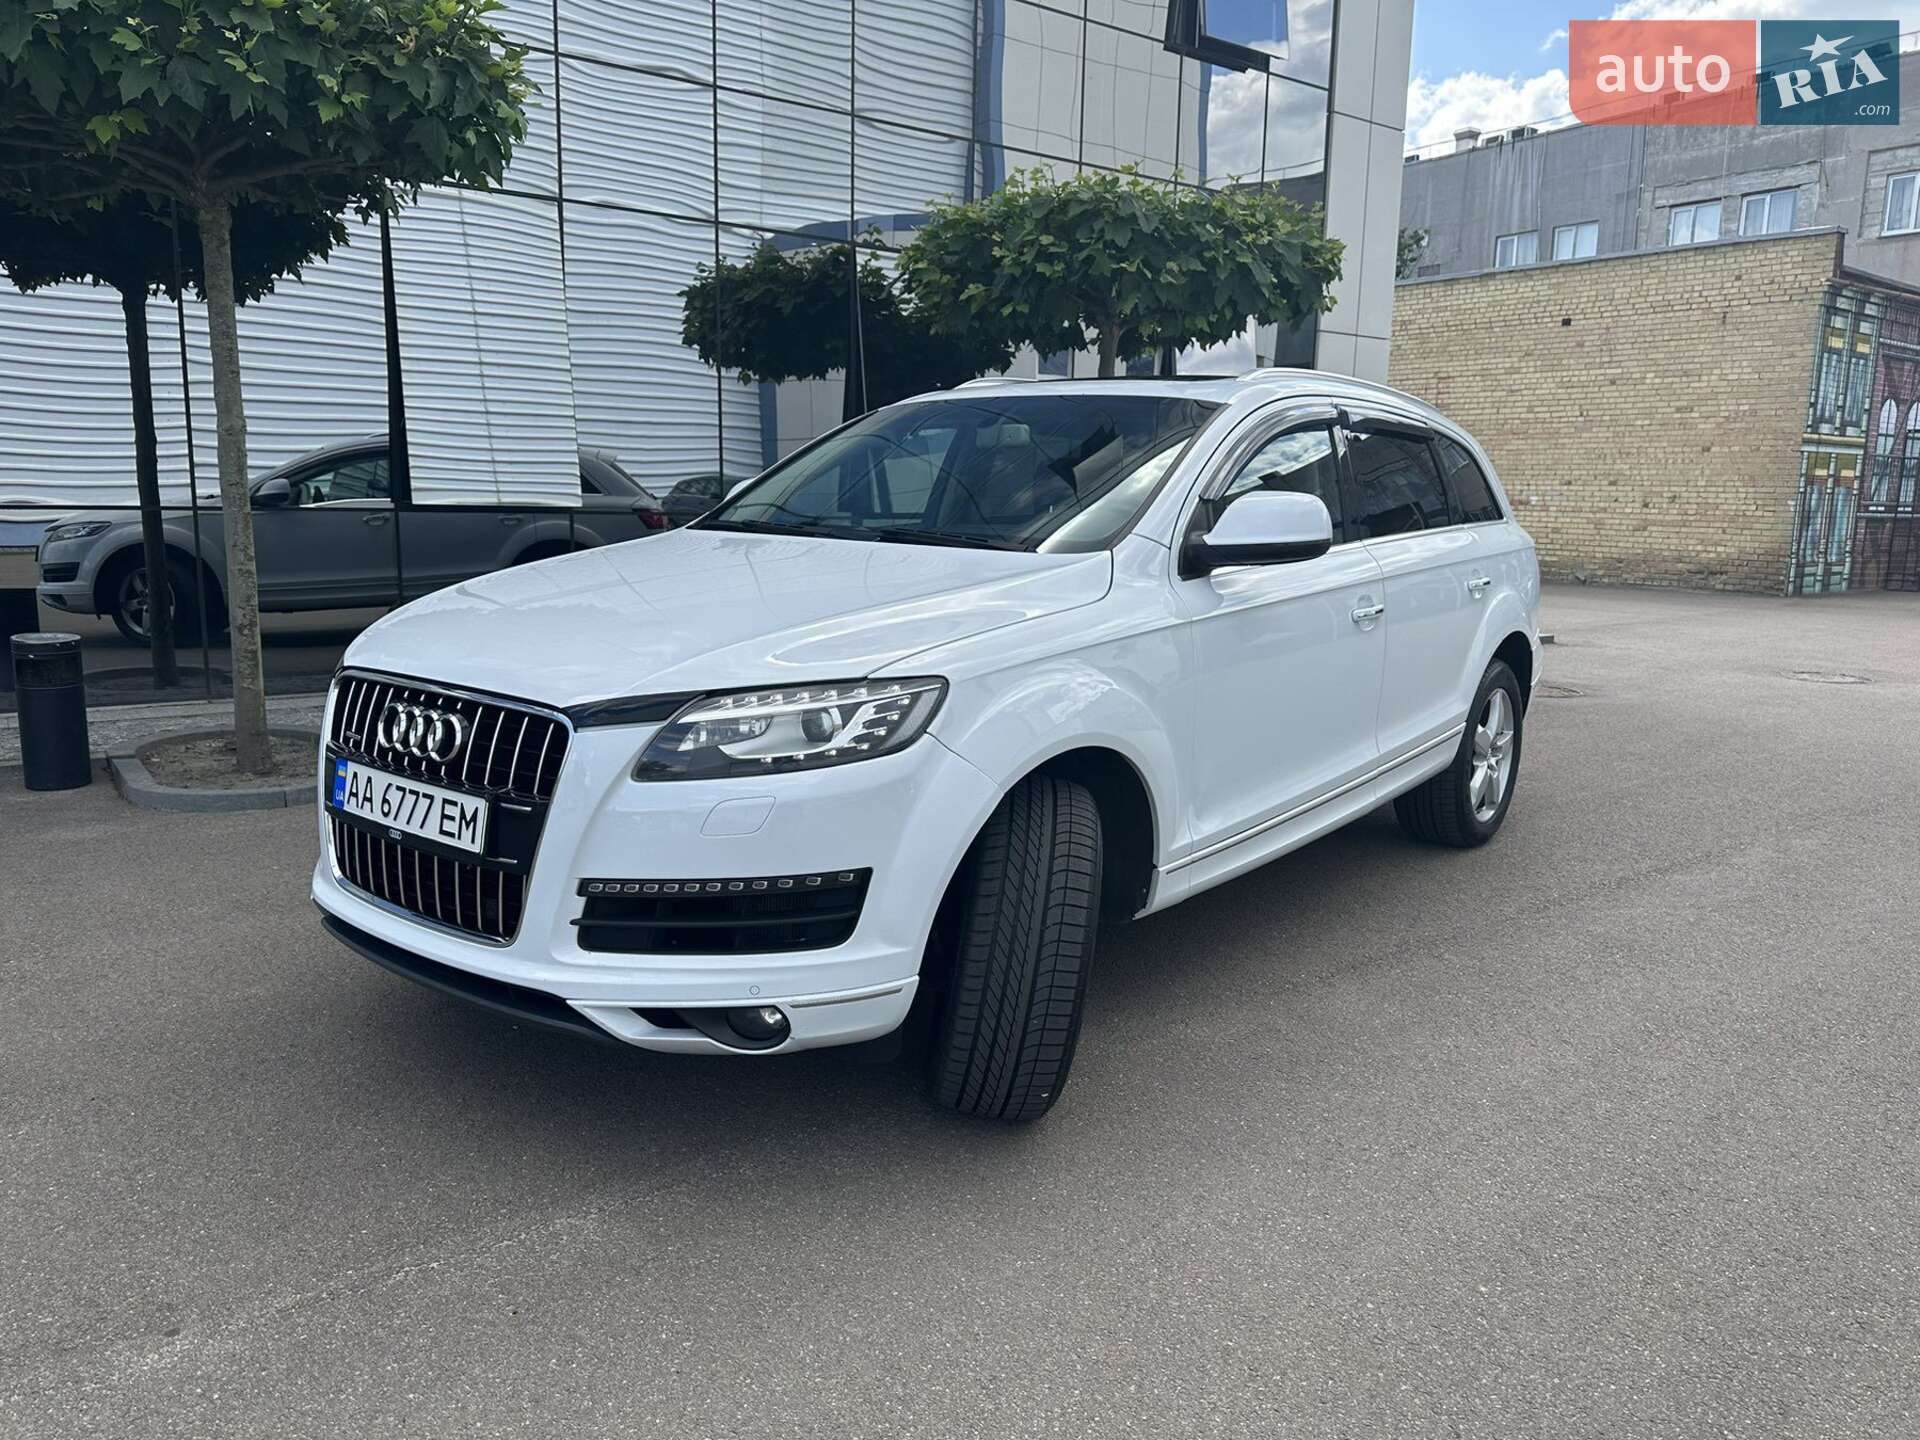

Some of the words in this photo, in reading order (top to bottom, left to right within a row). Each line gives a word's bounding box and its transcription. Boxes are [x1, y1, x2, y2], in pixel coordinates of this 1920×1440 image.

[335, 790, 345, 801] UA
[347, 771, 374, 813] AA
[380, 783, 434, 829] 6777
[439, 798, 479, 844] EM
